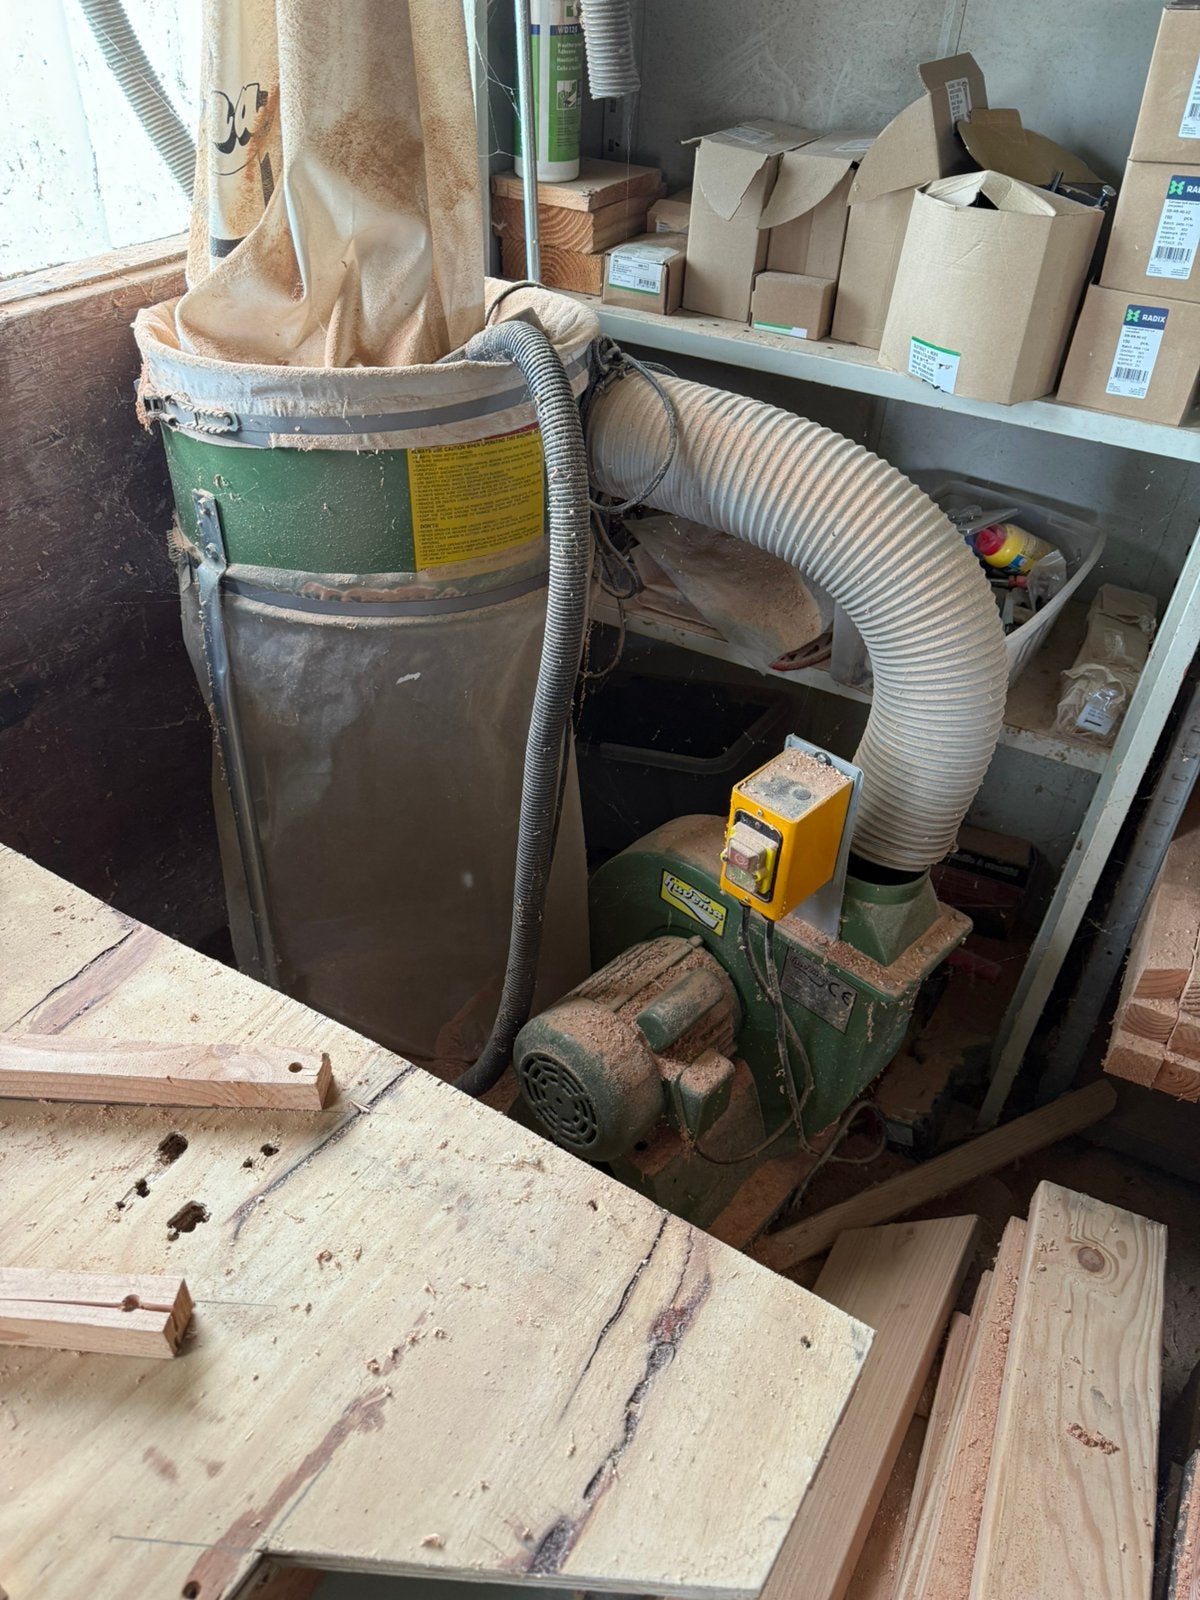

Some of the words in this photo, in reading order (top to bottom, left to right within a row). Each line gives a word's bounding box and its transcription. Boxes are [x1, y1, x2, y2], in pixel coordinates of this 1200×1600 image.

[1186, 185, 1200, 194] RA
[1142, 314, 1166, 323] RADIX
[444, 444, 466, 452] CAUTION
